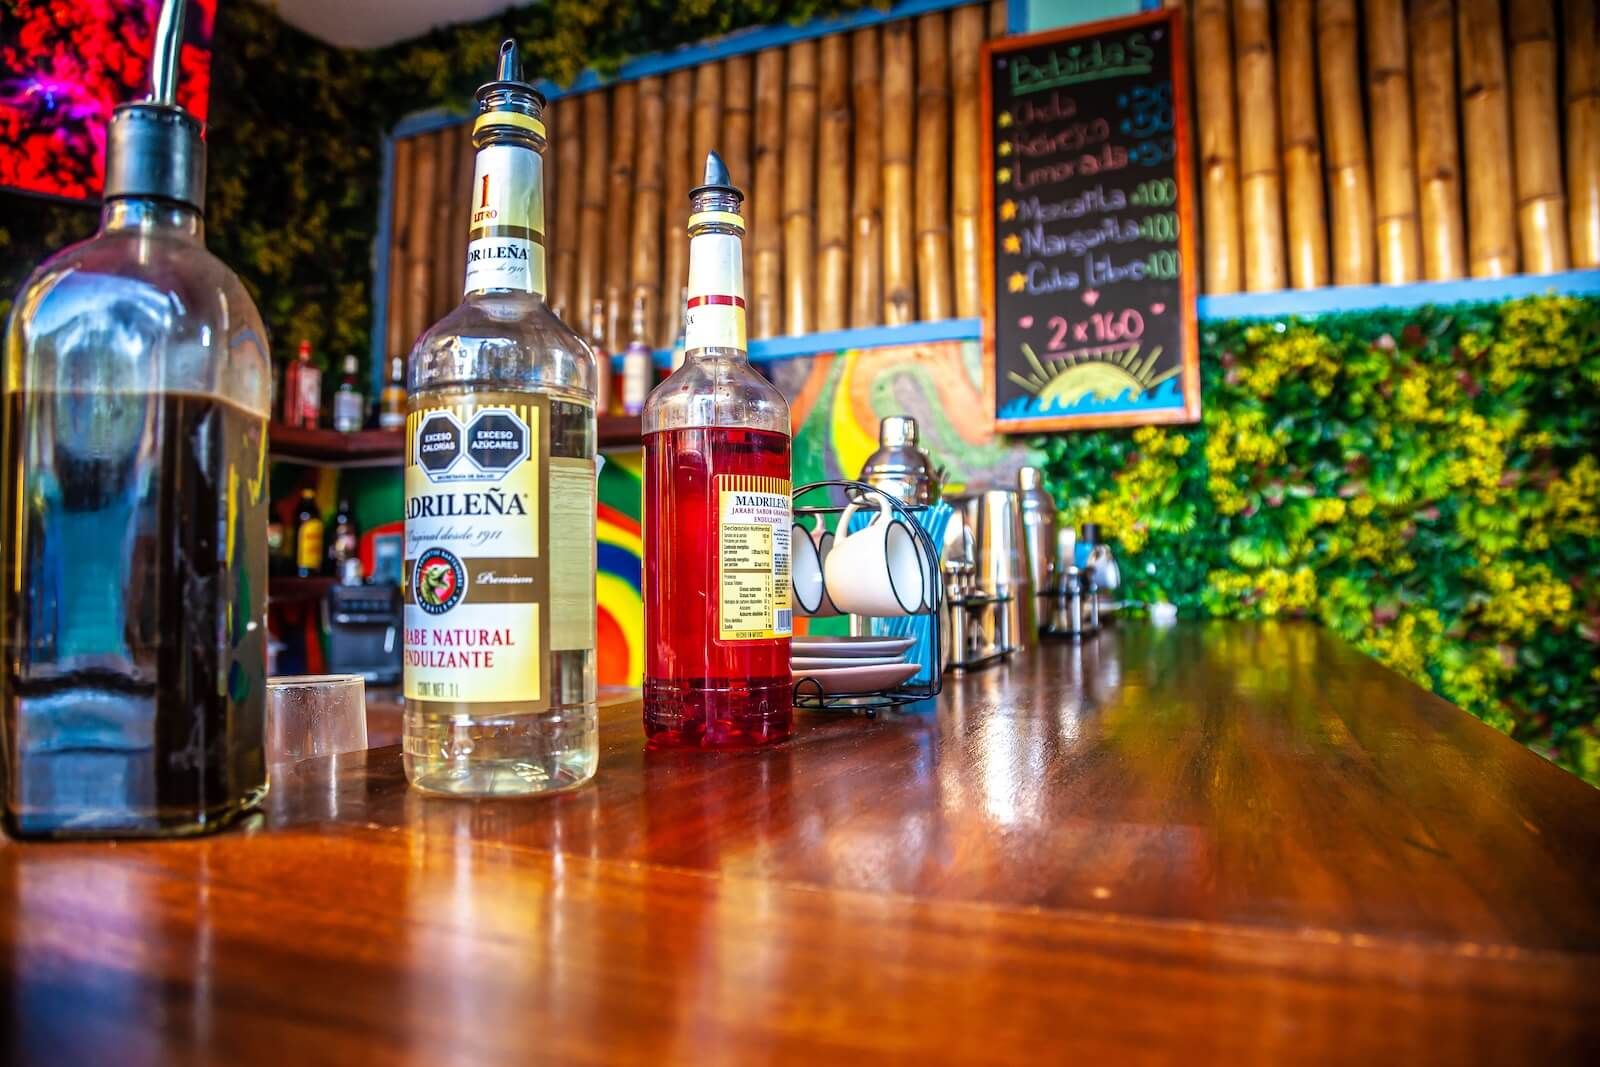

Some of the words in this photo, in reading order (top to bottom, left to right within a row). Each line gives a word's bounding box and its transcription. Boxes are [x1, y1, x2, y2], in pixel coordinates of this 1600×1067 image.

[481, 173, 490, 209] 1
[473, 209, 498, 223] LITRO
[1027, 261, 1080, 296] Cuba
[1047, 315, 1068, 349] 2
[1090, 308, 1145, 341] 160
[424, 432, 452, 443] EXCESO
[477, 430, 514, 440] EXCESO
[422, 441, 456, 453] CALORÍAS
[471, 440, 520, 450] AZÚCARES
[441, 525, 473, 541] desde
[475, 530, 503, 546] 1911
[475, 571, 534, 585] Premium
[432, 629, 516, 647] NATURAL
